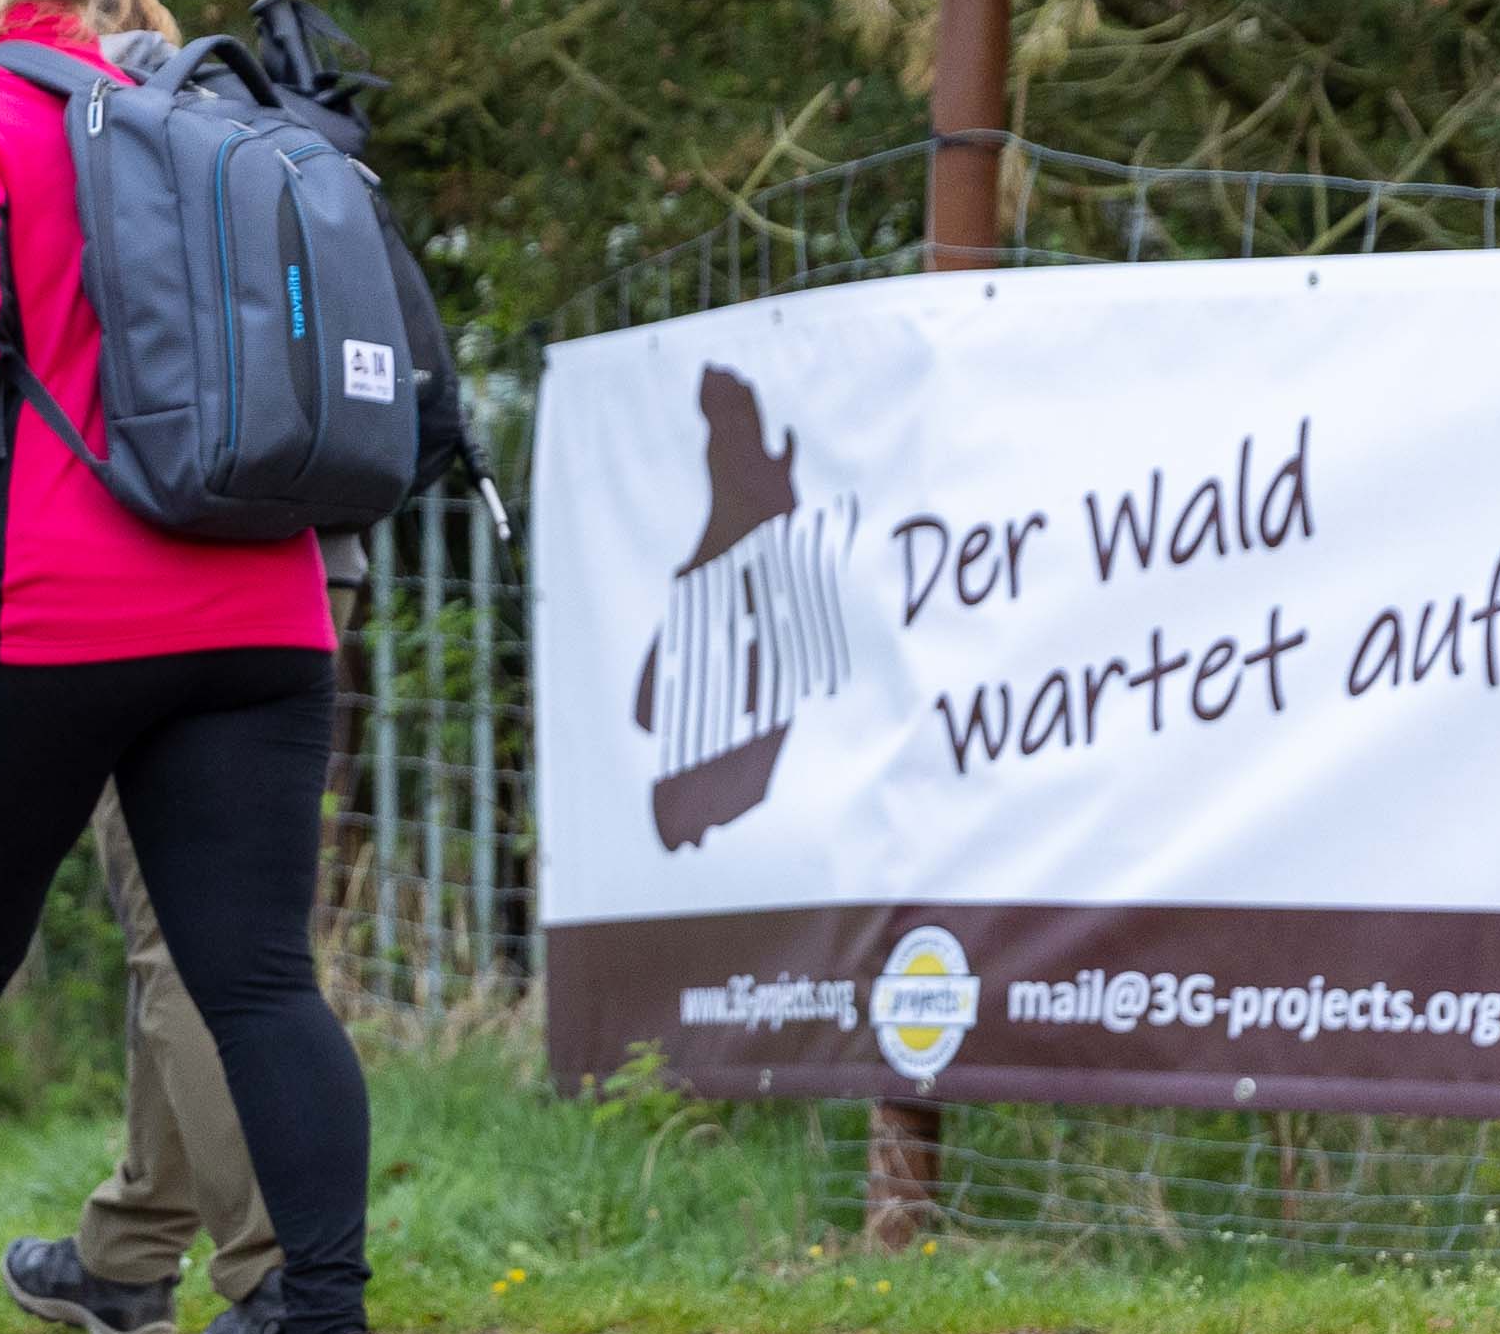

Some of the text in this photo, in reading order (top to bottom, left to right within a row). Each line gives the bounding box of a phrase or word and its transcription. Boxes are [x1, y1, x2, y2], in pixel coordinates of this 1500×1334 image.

[893, 417, 1314, 627] Der Wald
[935, 607, 1307, 775] wartet
